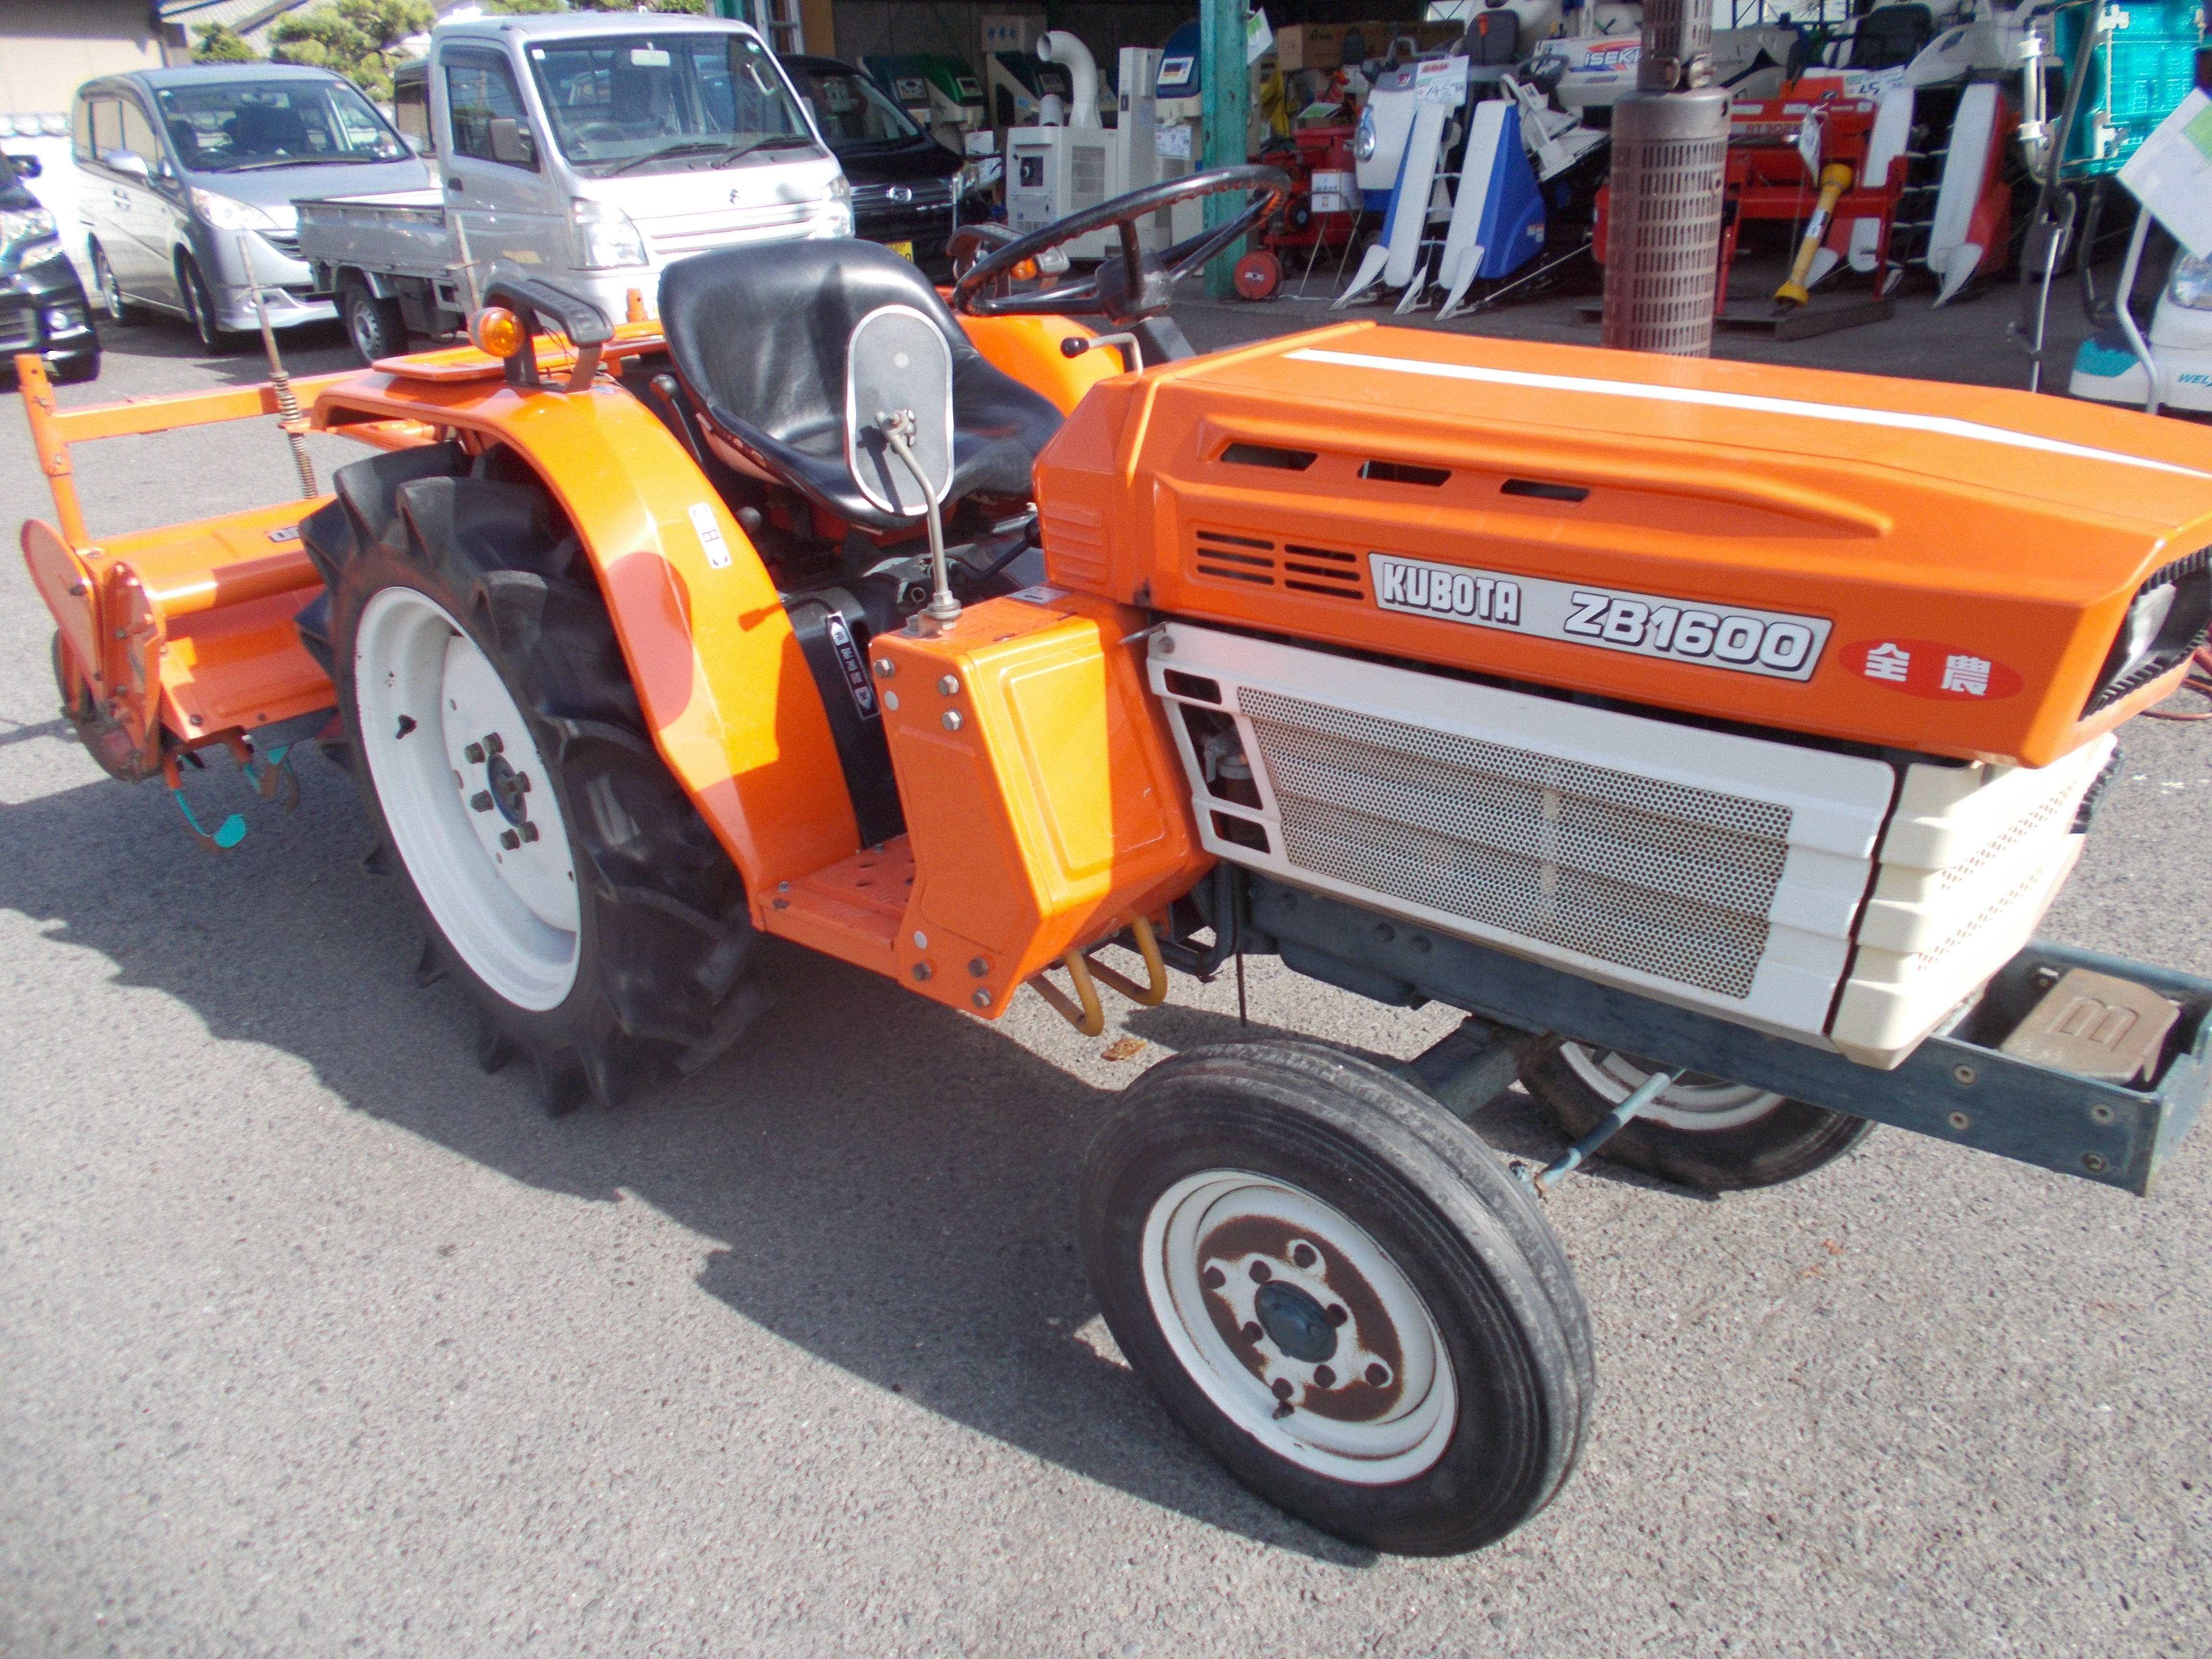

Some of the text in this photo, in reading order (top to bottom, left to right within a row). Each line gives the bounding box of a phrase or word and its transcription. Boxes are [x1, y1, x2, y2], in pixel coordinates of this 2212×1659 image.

[1584, 47, 1641, 66] ISEKI
[2177, 373, 2212, 387] WEL
[1383, 562, 1815, 672] KUBOTA ZB1600
[1864, 641, 1992, 696] 全農
